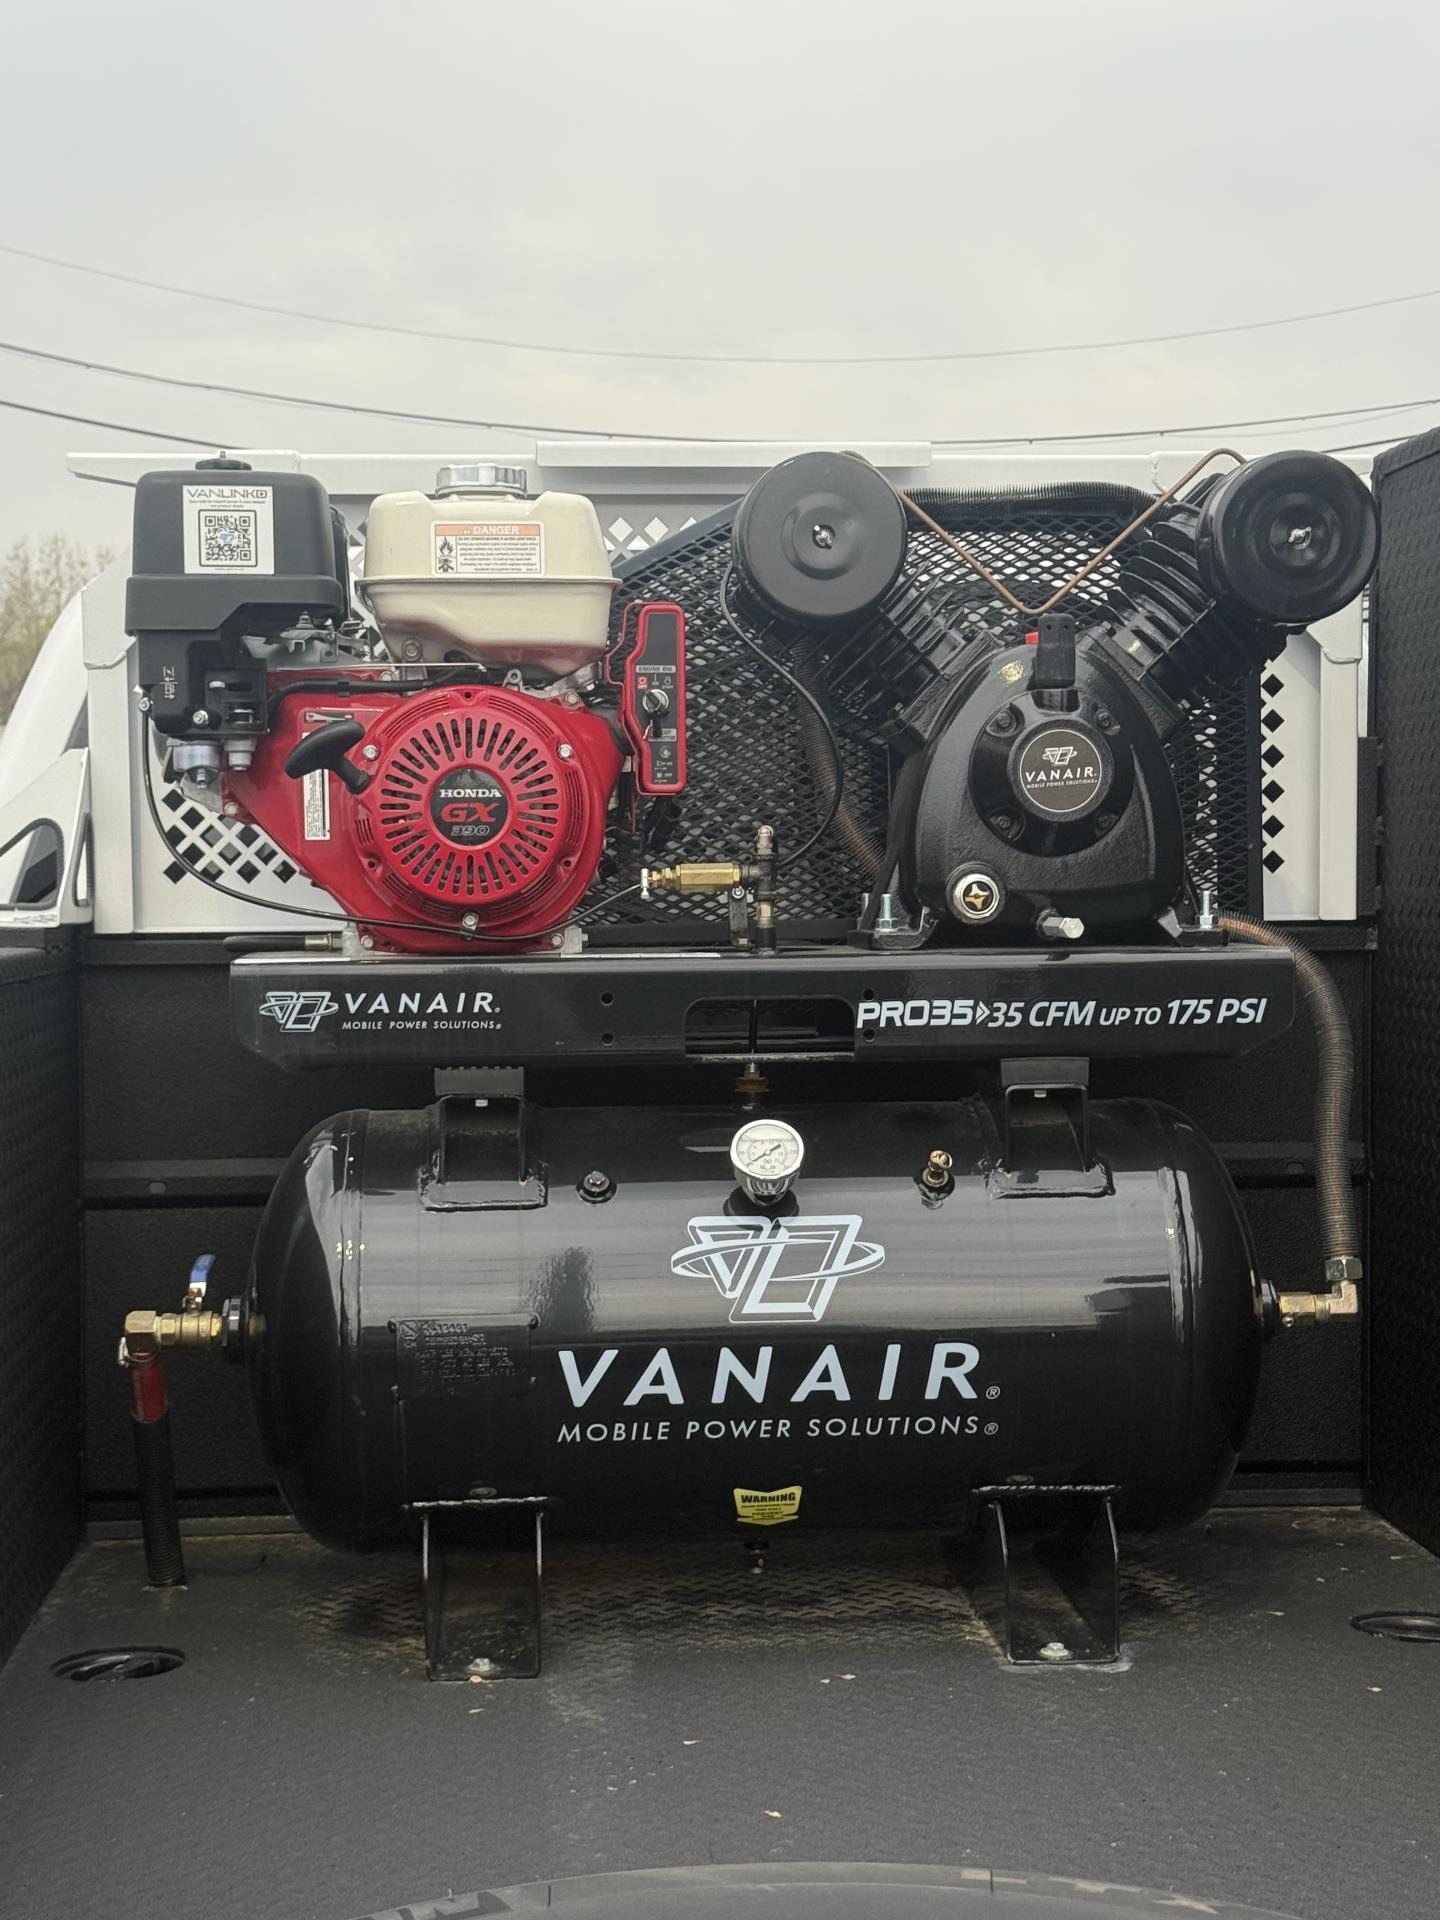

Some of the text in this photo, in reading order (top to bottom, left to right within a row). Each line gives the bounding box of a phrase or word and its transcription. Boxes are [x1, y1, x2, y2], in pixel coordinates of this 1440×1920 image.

[473, 526, 520, 535] DANGER
[440, 788, 502, 798] HONDA
[440, 802, 500, 823] GX
[451, 825, 490, 836] 390
[1029, 1000, 1097, 1027] CFM
[1099, 1007, 1131, 1025] UP
[1134, 1007, 1162, 1025] TO
[1167, 998, 1214, 1025] 175
[1216, 998, 1268, 1024] PSI
[342, 1020, 383, 1030] MOBILE
[389, 1020, 428, 1030] POWER
[558, 1421, 671, 1443] MOBILE
[686, 1419, 791, 1440] POWER
[741, 1492, 796, 1504] WARNING
